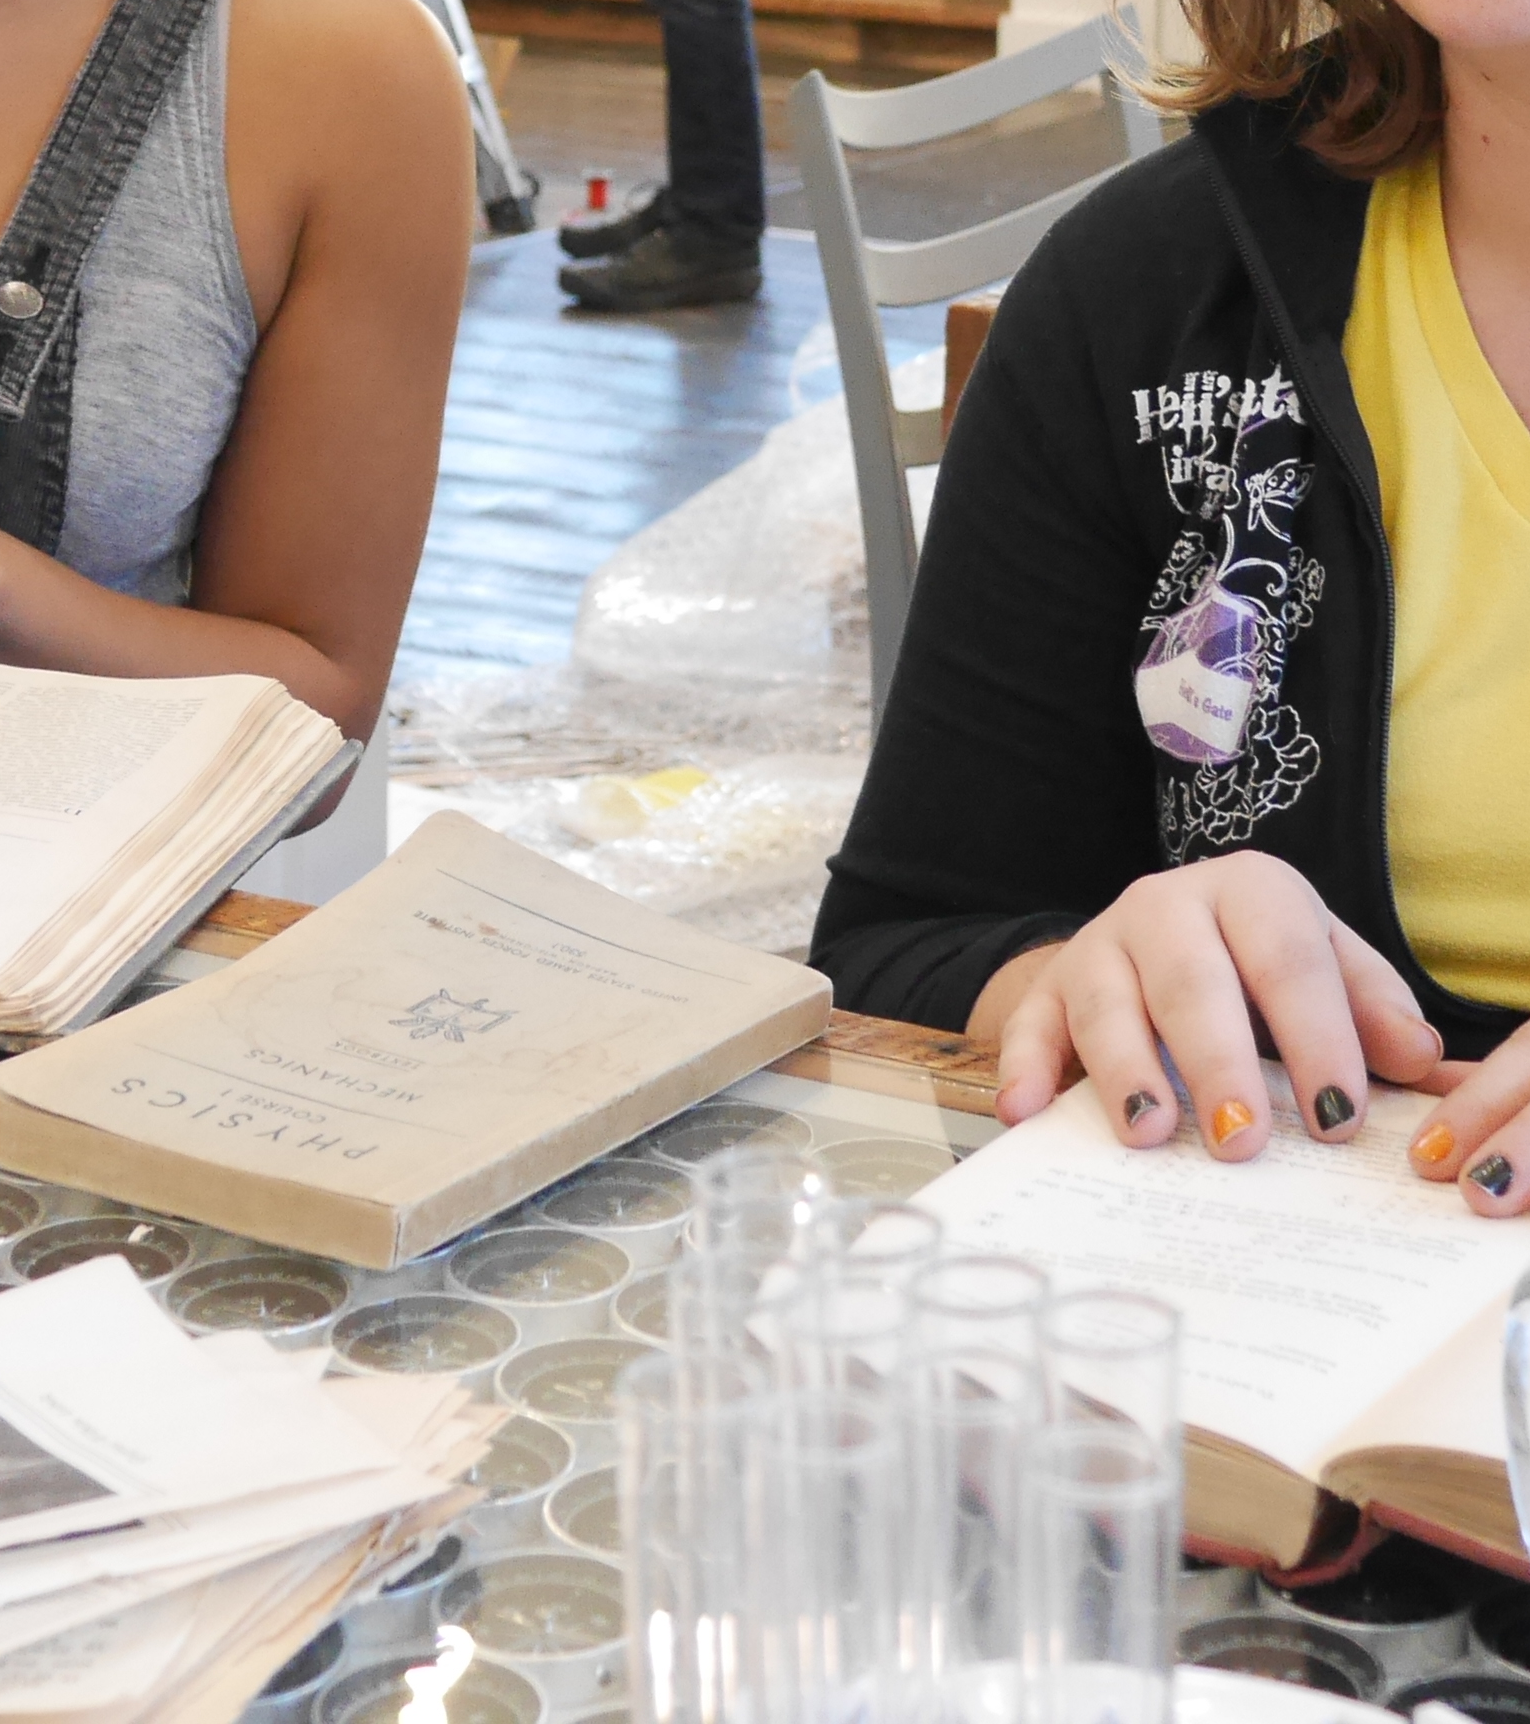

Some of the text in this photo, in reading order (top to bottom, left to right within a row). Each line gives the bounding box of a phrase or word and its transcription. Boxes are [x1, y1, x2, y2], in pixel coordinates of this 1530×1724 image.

[478, 935, 530, 959] FORCES
[535, 956, 582, 975] ARMED
[586, 972, 635, 991] STATES
[639, 987, 690, 1005] UNITED
[243, 1047, 424, 1104] MECHANICS
[111, 1077, 378, 1160] PHYSICS
[236, 1092, 327, 1125] COURSE
